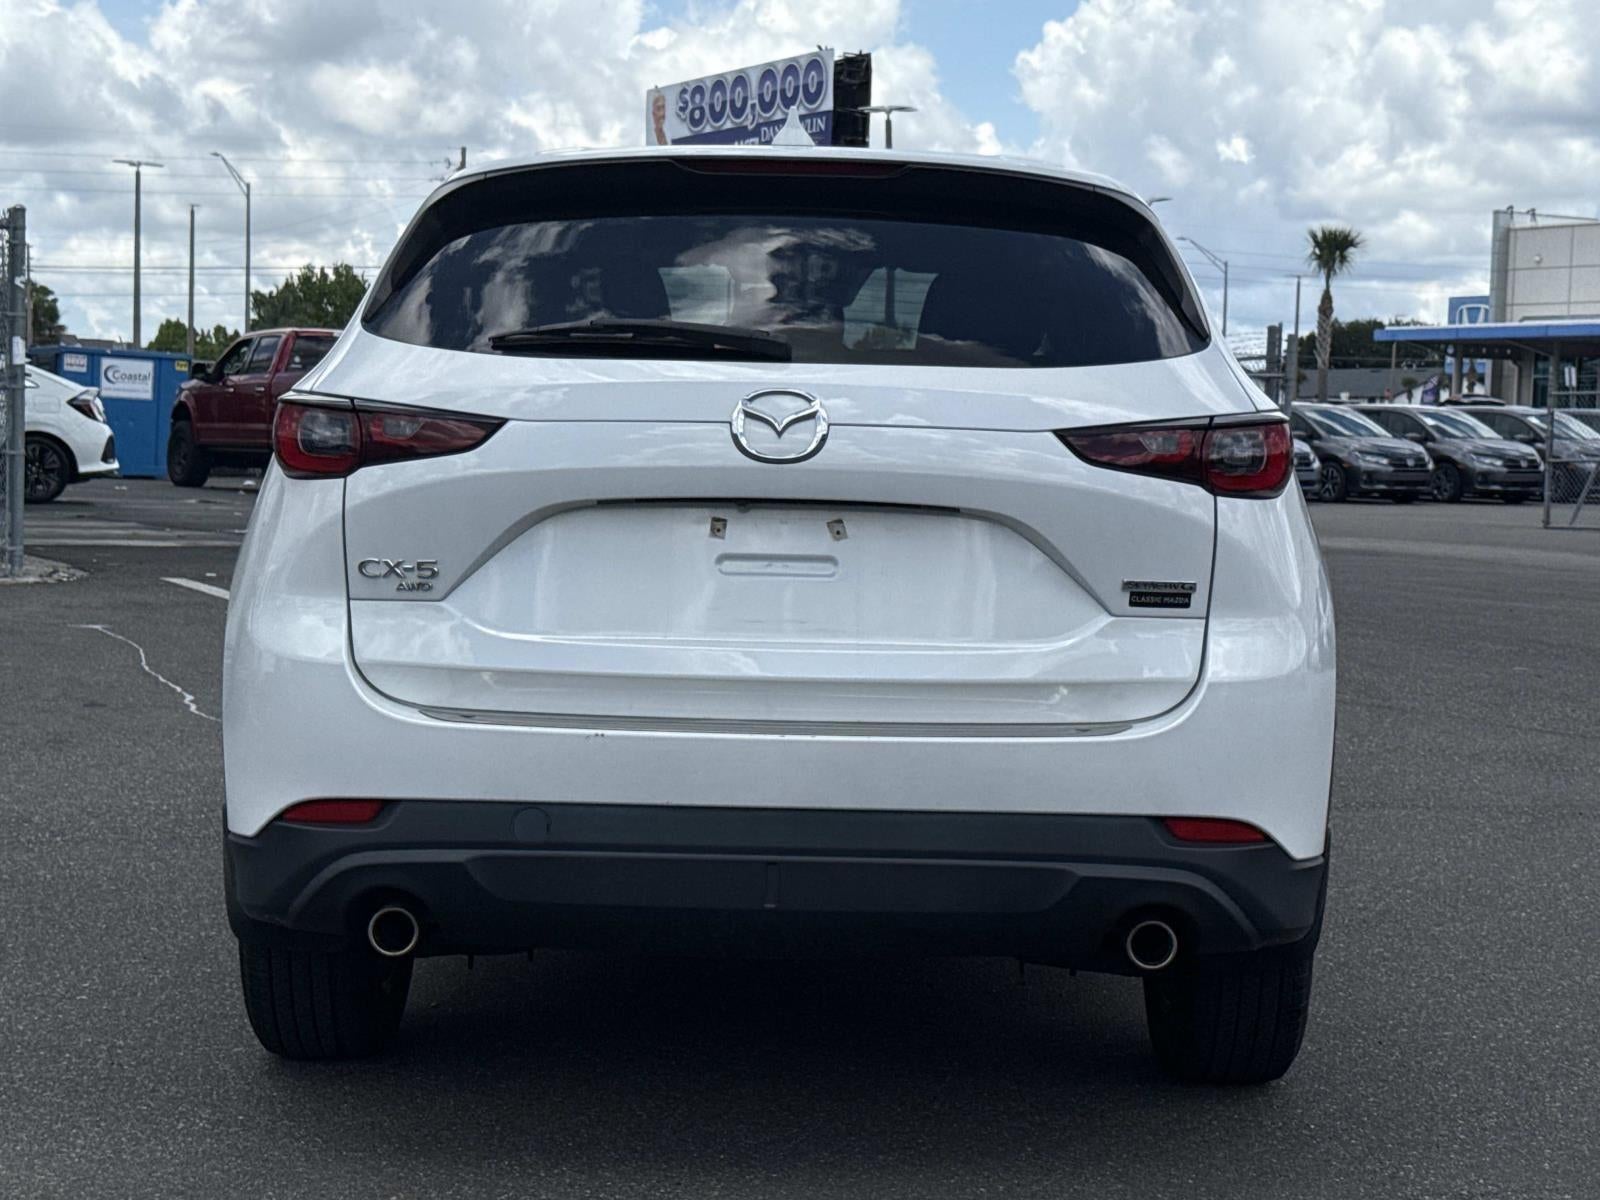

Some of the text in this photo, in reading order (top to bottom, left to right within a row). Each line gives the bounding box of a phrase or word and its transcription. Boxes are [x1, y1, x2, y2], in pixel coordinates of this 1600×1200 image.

[677, 56, 826, 132] $800,000
[112, 368, 151, 382] Coastal
[358, 557, 439, 579] CX-5
[396, 581, 434, 592] AWD
